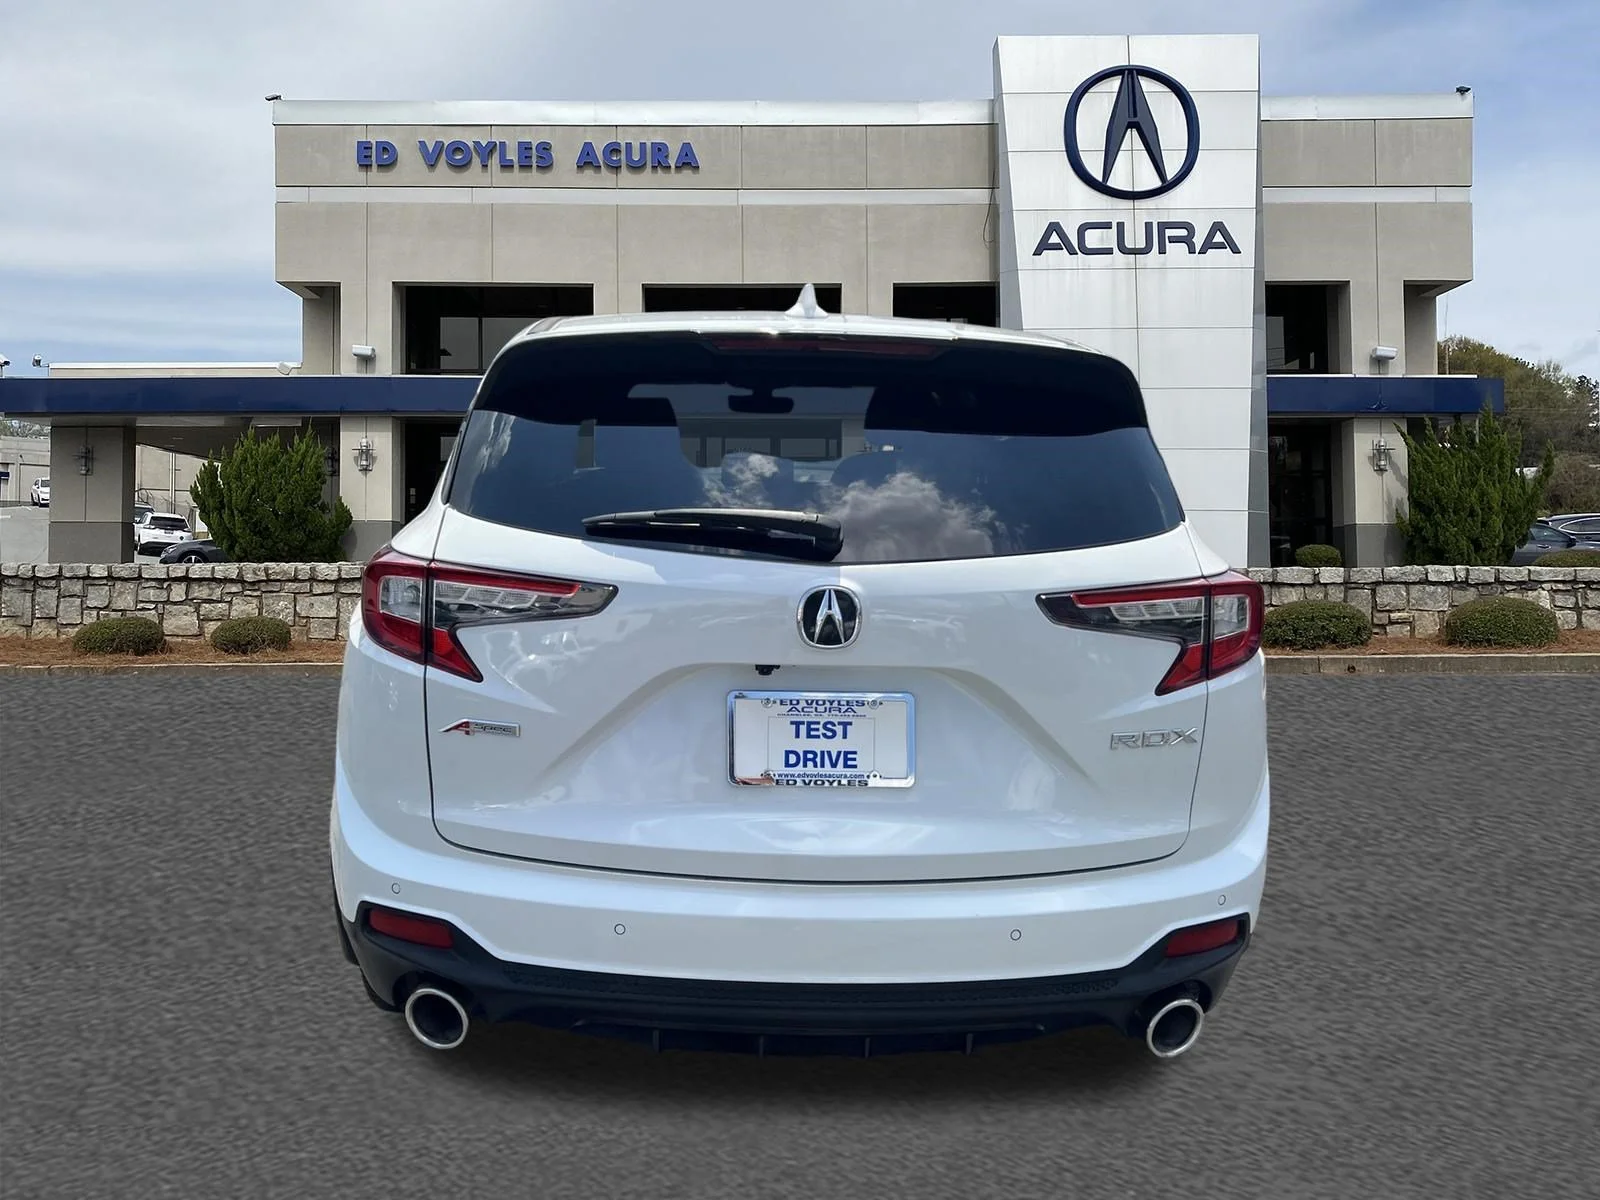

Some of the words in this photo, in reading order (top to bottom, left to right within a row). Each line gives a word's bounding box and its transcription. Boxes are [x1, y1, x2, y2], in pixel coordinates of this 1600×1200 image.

[356, 140, 398, 167] ED
[418, 140, 554, 168] VOYLES
[576, 141, 701, 168] ACURA
[1032, 221, 1242, 256] ACURA
[787, 706, 857, 714] ACURA
[802, 699, 866, 707] VOYLES
[790, 720, 853, 739] TEST
[1110, 728, 1198, 750] RDX
[784, 749, 858, 769] DRIVE
[777, 772, 865, 780] www.edvoylesacura.com
[801, 779, 869, 787] VOYLES
